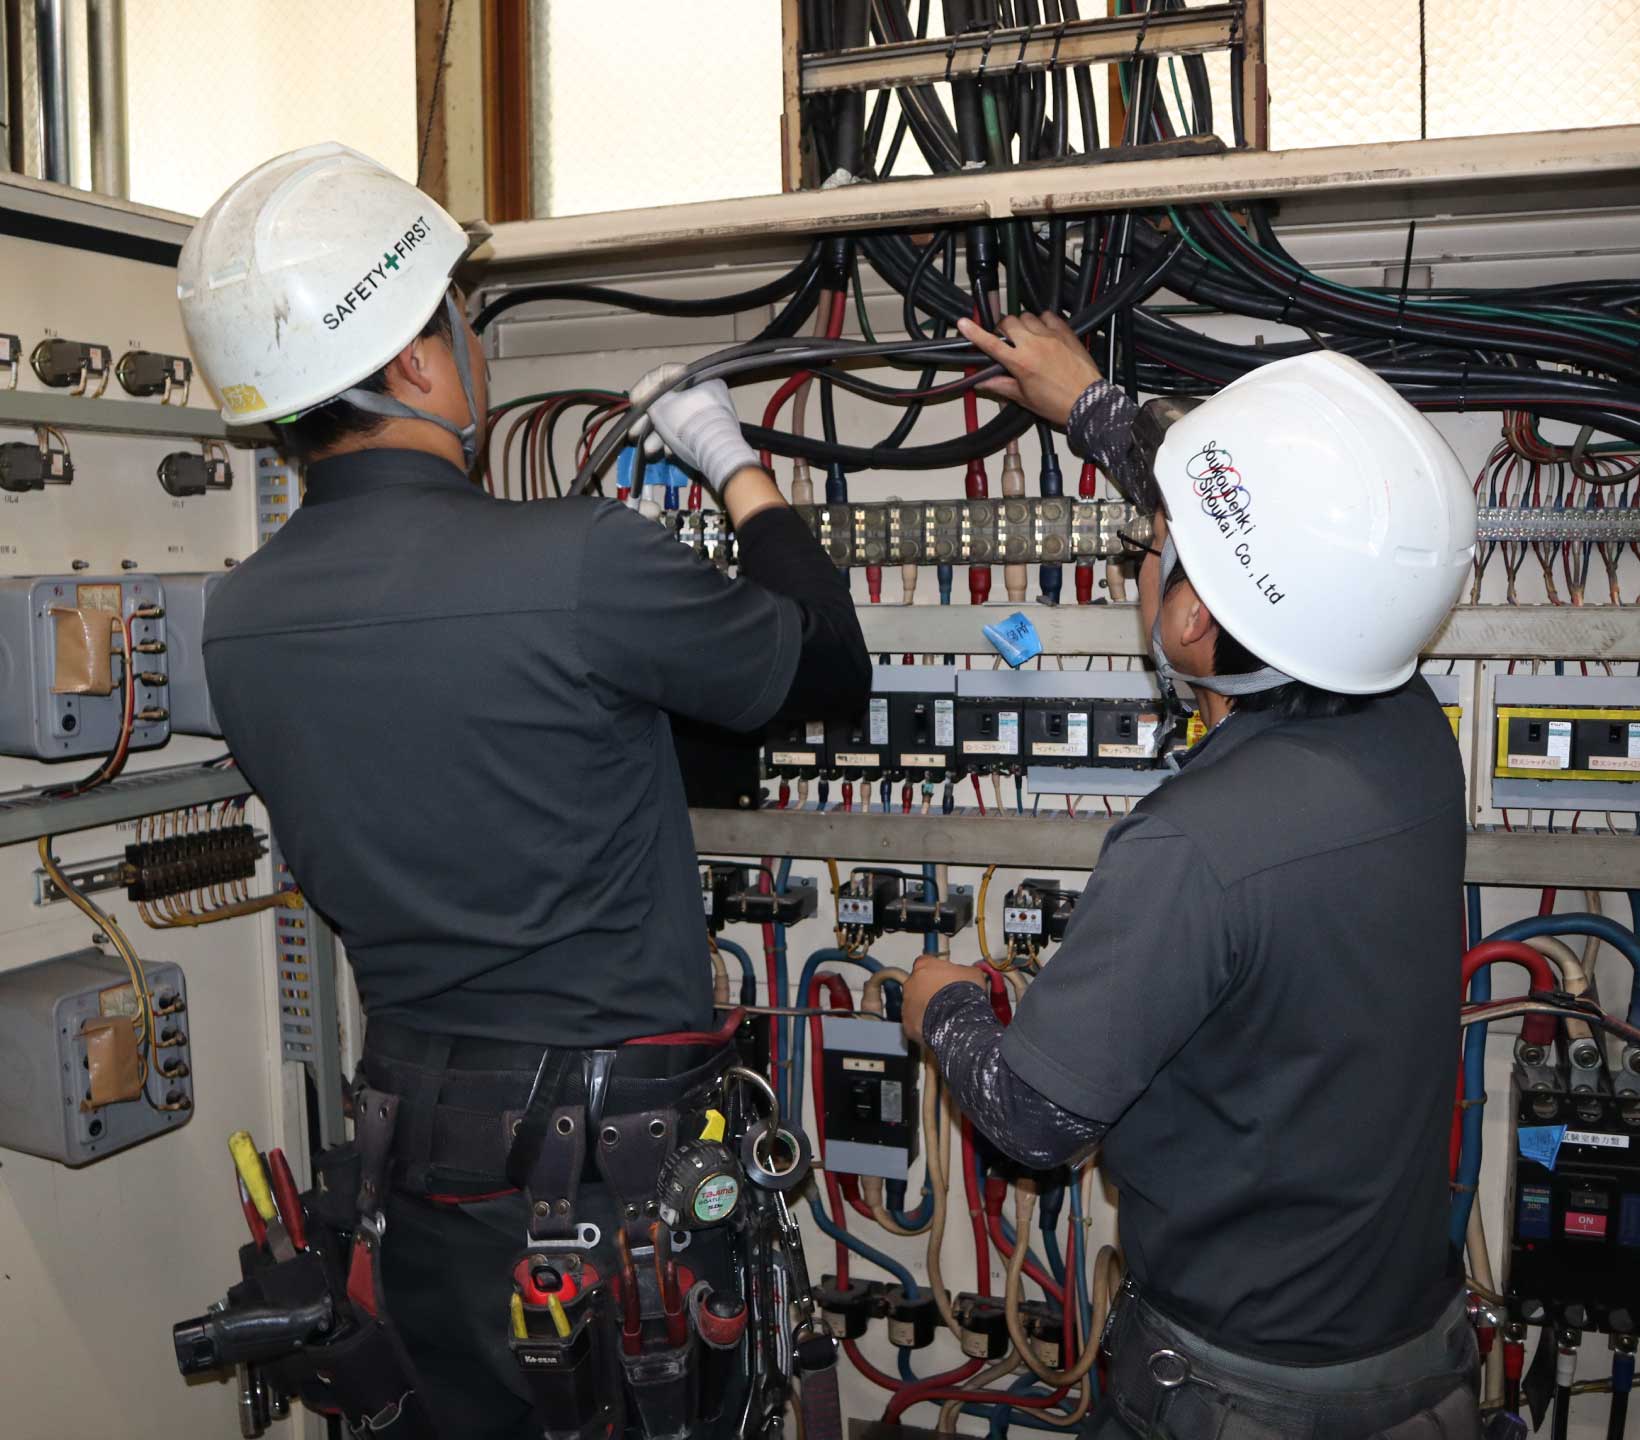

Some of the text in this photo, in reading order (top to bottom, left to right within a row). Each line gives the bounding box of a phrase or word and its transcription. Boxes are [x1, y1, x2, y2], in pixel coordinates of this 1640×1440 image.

[323, 216, 431, 330] SAFETY FIRST
[1256, 574, 1285, 604] Ltd
[1578, 1215, 1594, 1225] ON
